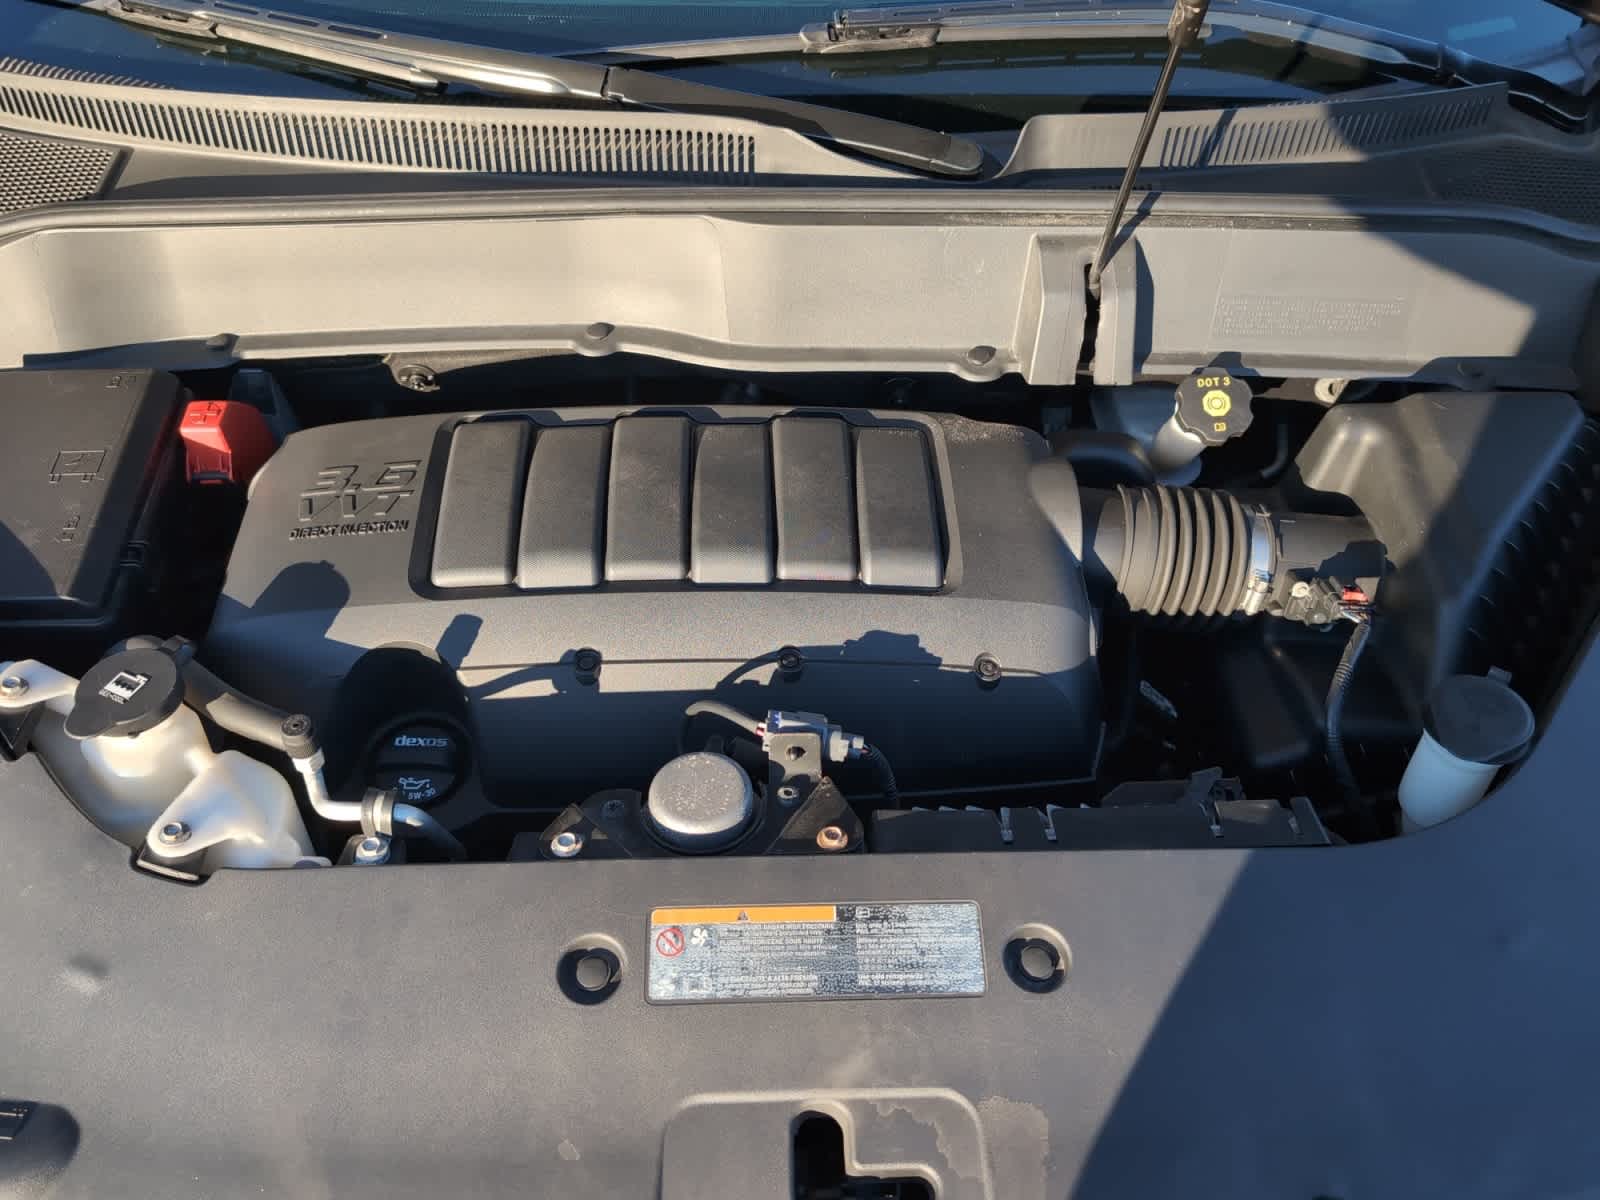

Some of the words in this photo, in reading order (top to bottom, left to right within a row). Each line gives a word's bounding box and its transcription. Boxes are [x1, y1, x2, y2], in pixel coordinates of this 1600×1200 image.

[1197, 377, 1220, 388] DOT
[1223, 376, 1231, 386] 3
[299, 489, 415, 521] VVT
[289, 523, 339, 541] DIRECT
[339, 519, 409, 537] INJECTION
[394, 735, 449, 748] dexos
